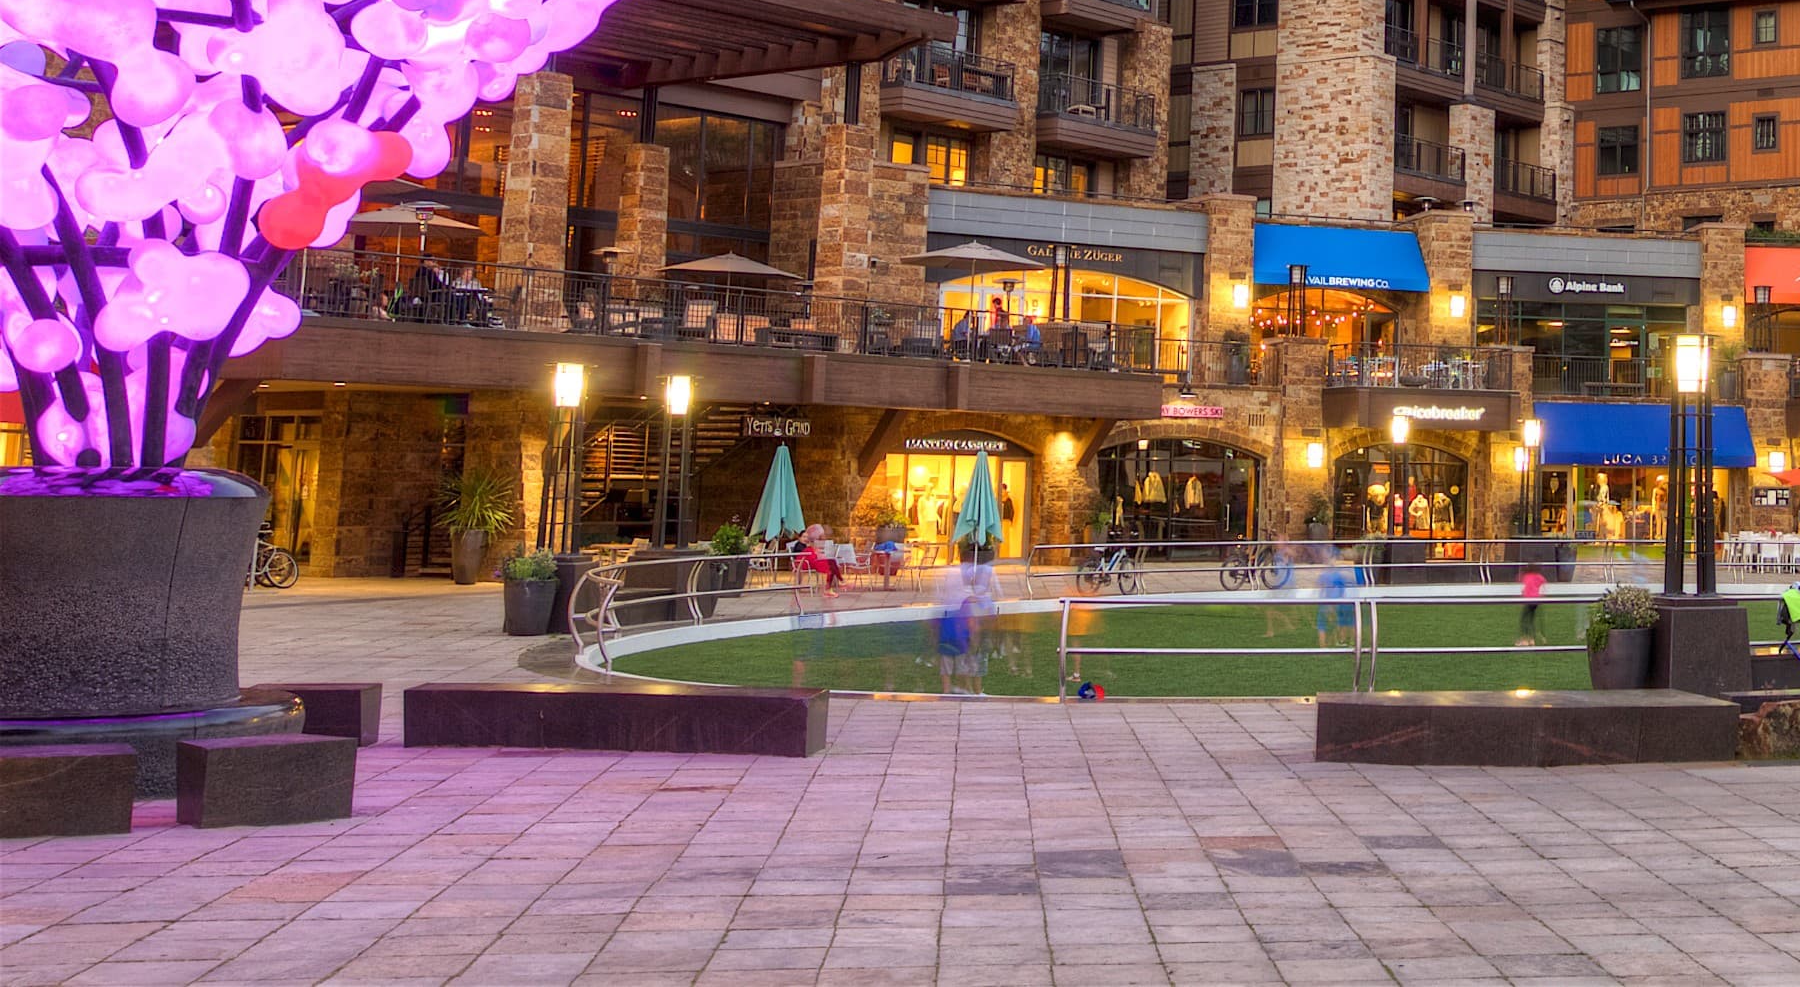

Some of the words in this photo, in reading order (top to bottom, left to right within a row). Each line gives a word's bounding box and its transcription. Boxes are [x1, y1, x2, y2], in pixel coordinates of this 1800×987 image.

[1329, 276, 1374, 288] BREWING
[1565, 281, 1598, 293] Alpine
[1599, 282, 1625, 293] Bank
[1173, 407, 1208, 416] BOWERS
[1413, 405, 1484, 421] icebreaker
[1603, 453, 1643, 465] LUCA
